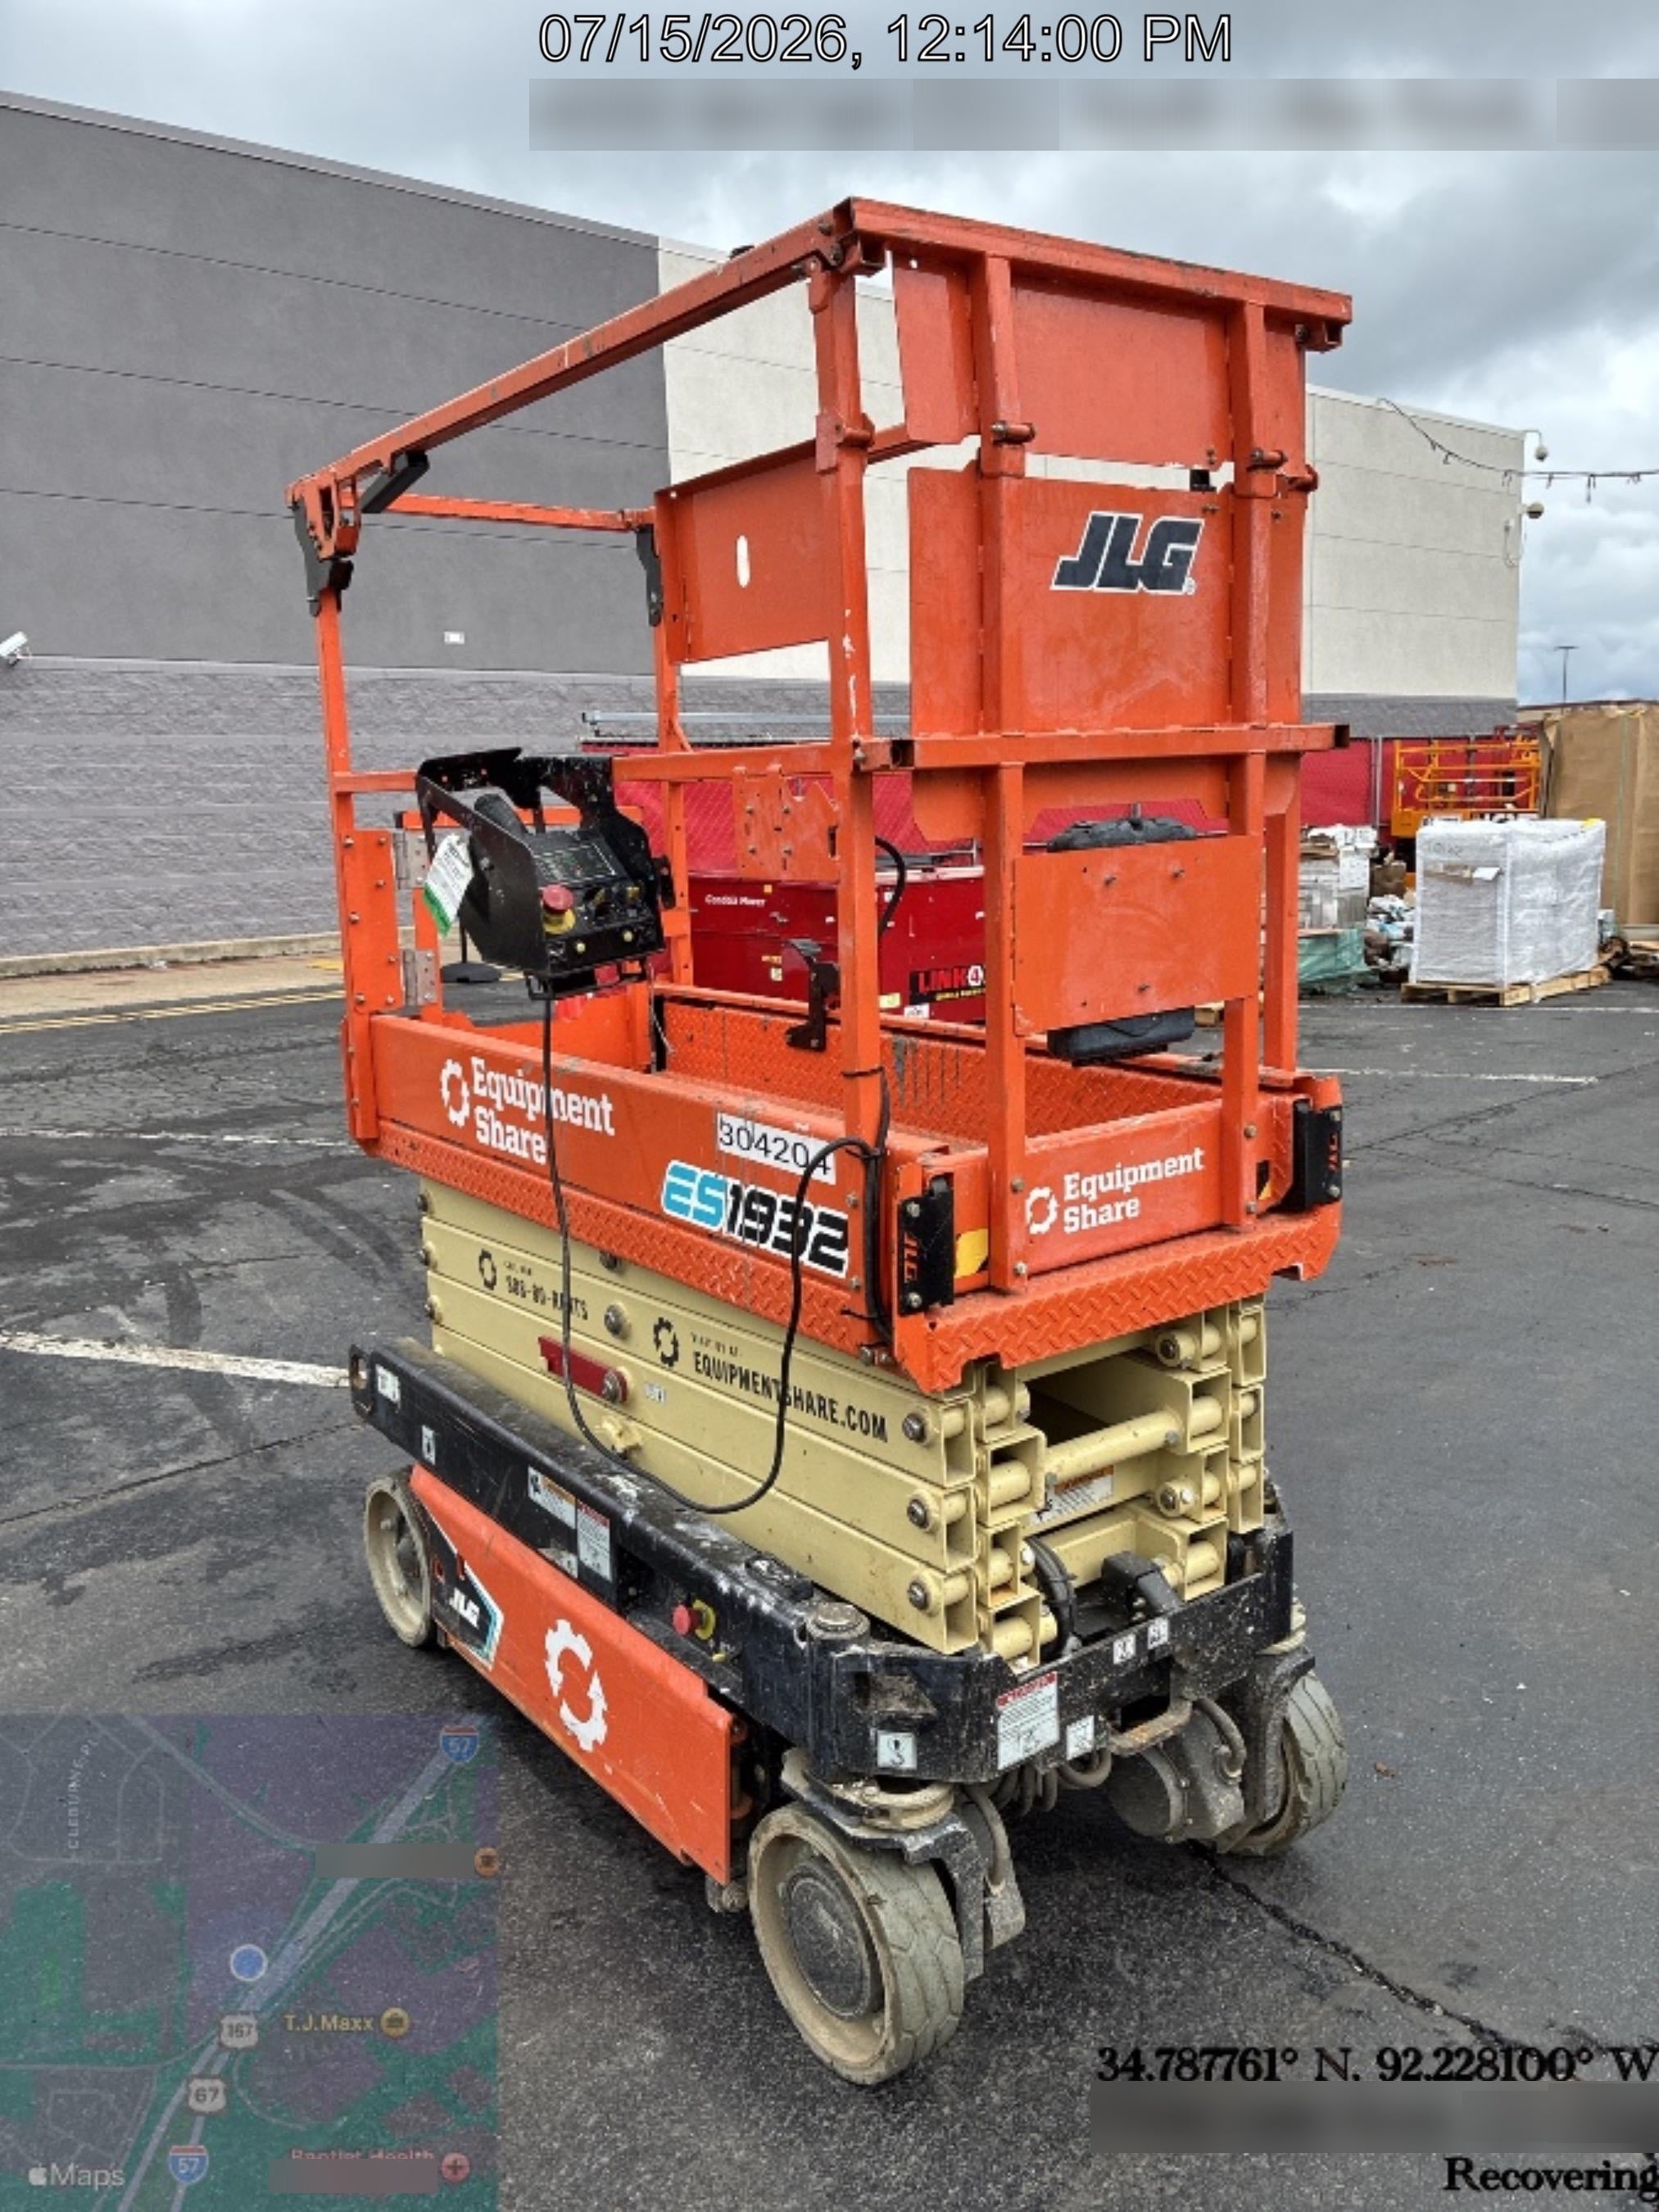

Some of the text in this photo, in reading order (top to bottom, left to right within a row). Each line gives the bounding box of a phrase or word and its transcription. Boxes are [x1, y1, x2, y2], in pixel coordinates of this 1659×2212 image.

[1050, 510, 1205, 596] JLG
[471, 1056, 615, 1136] Equipment
[475, 1105, 546, 1166] Share
[718, 1121, 831, 1176] 304204
[1063, 1147, 1206, 1202] Equipment
[662, 1159, 849, 1279] ES1932
[1063, 1198, 1140, 1235] Share
